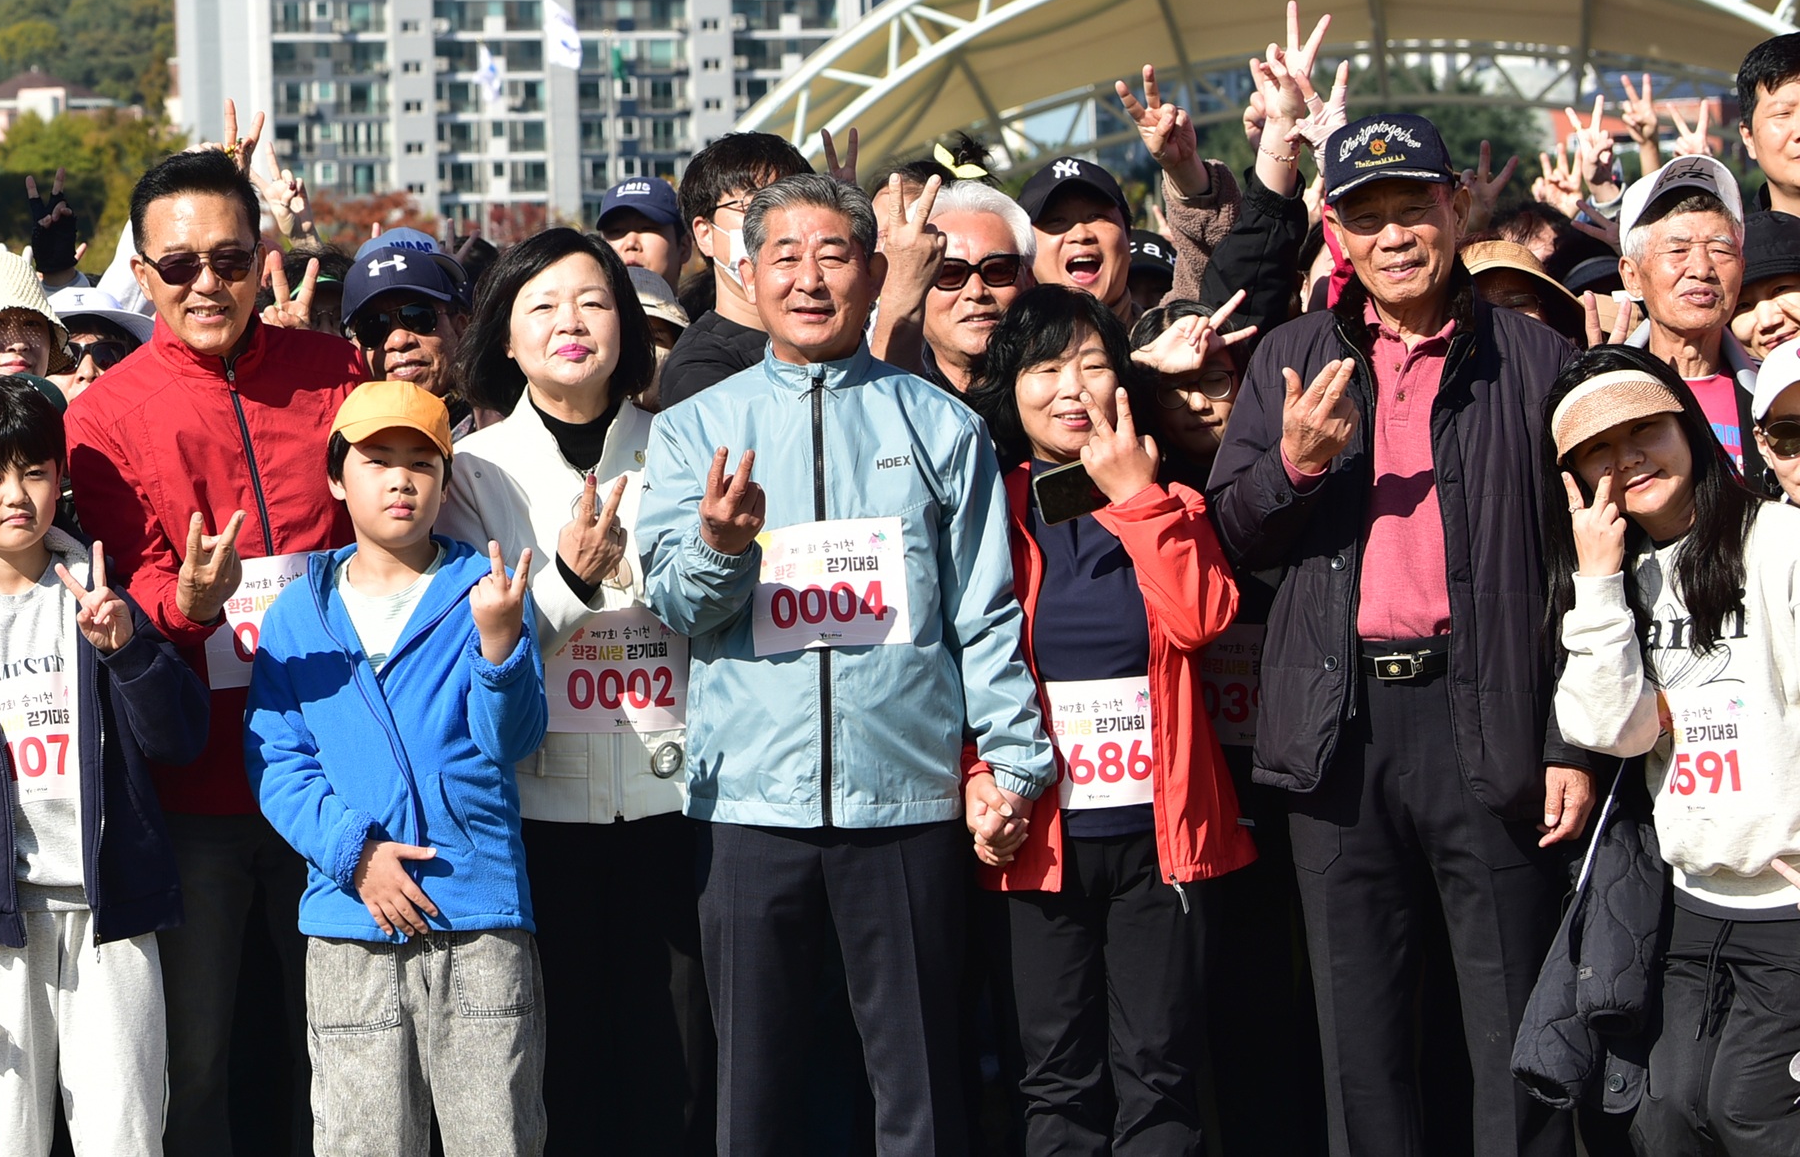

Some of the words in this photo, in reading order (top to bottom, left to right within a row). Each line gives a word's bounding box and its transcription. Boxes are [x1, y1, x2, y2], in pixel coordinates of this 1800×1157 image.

[876, 455, 912, 470] HDEX
[790, 544, 816, 555] 제회
[821, 539, 855, 553] 승기천
[825, 555, 879, 574] 걷기대회
[245, 578, 272, 590] 제7회
[770, 580, 889, 630] 0004
[590, 628, 618, 640] 제7회
[622, 625, 651, 640] 승기천
[571, 643, 624, 661] 환경사랑
[626, 641, 668, 660] 걷기대회
[567, 666, 676, 710] 0002
[21, 691, 53, 708] 승기천
[1058, 703, 1086, 714] 제7회
[1091, 698, 1123, 714] 승기천
[1681, 706, 1713, 722] 승기천
[1052, 719, 1093, 736] 경사랑
[1095, 714, 1146, 734] 걷기대회
[1685, 723, 1739, 743] 걷기대회
[1670, 749, 1742, 796] 591
